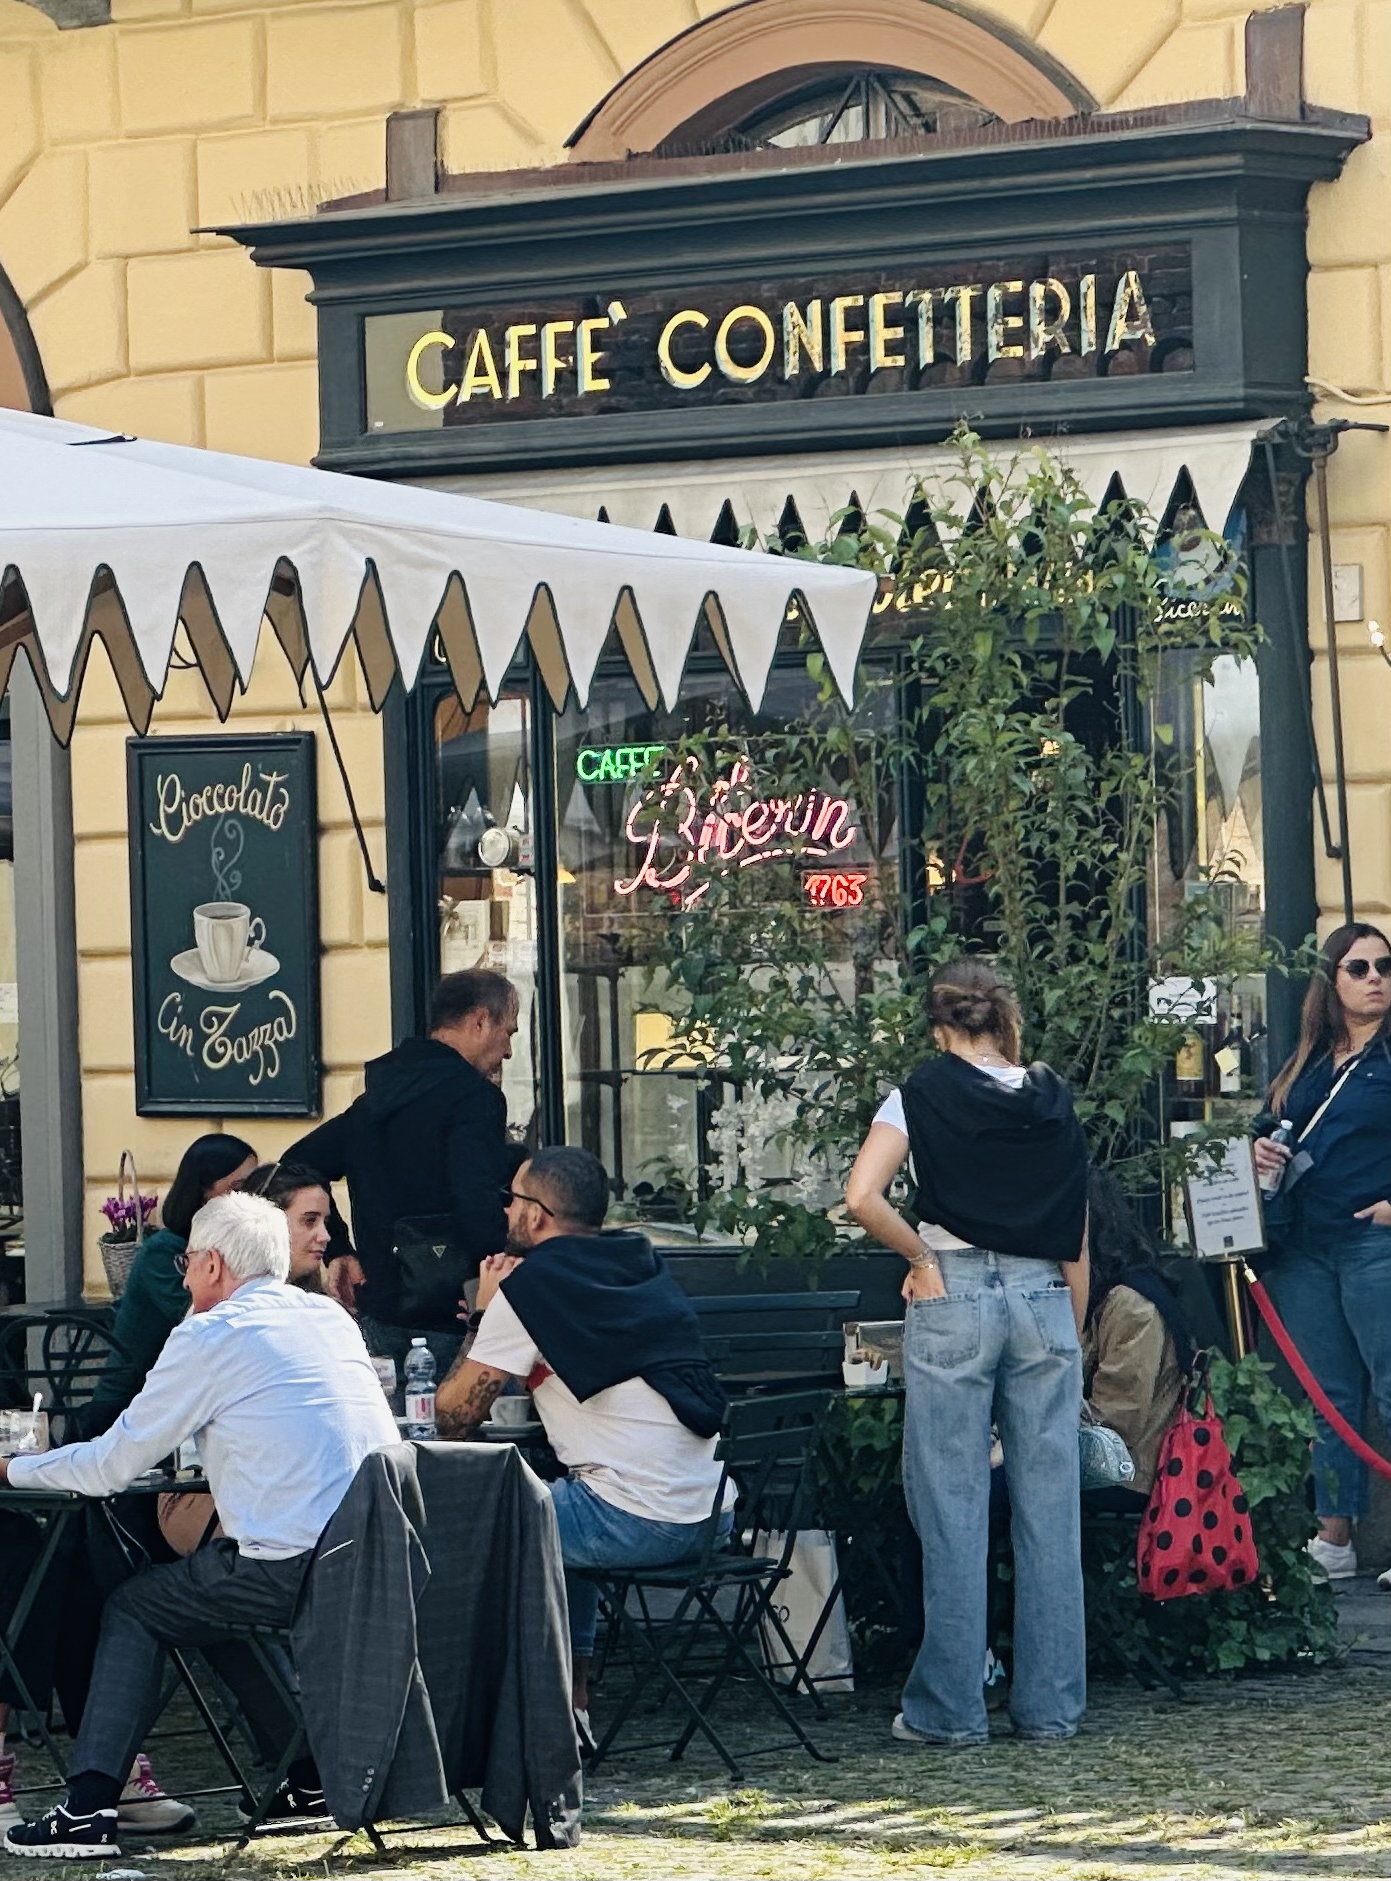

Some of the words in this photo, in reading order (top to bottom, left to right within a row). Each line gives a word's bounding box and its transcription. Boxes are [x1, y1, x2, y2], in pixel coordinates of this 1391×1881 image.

[659, 270, 1156, 388] CONFETTERIA
[150, 762, 290, 843] Cioccolato
[804, 874, 867, 907] 1763
[199, 989, 297, 1086] Tazza
